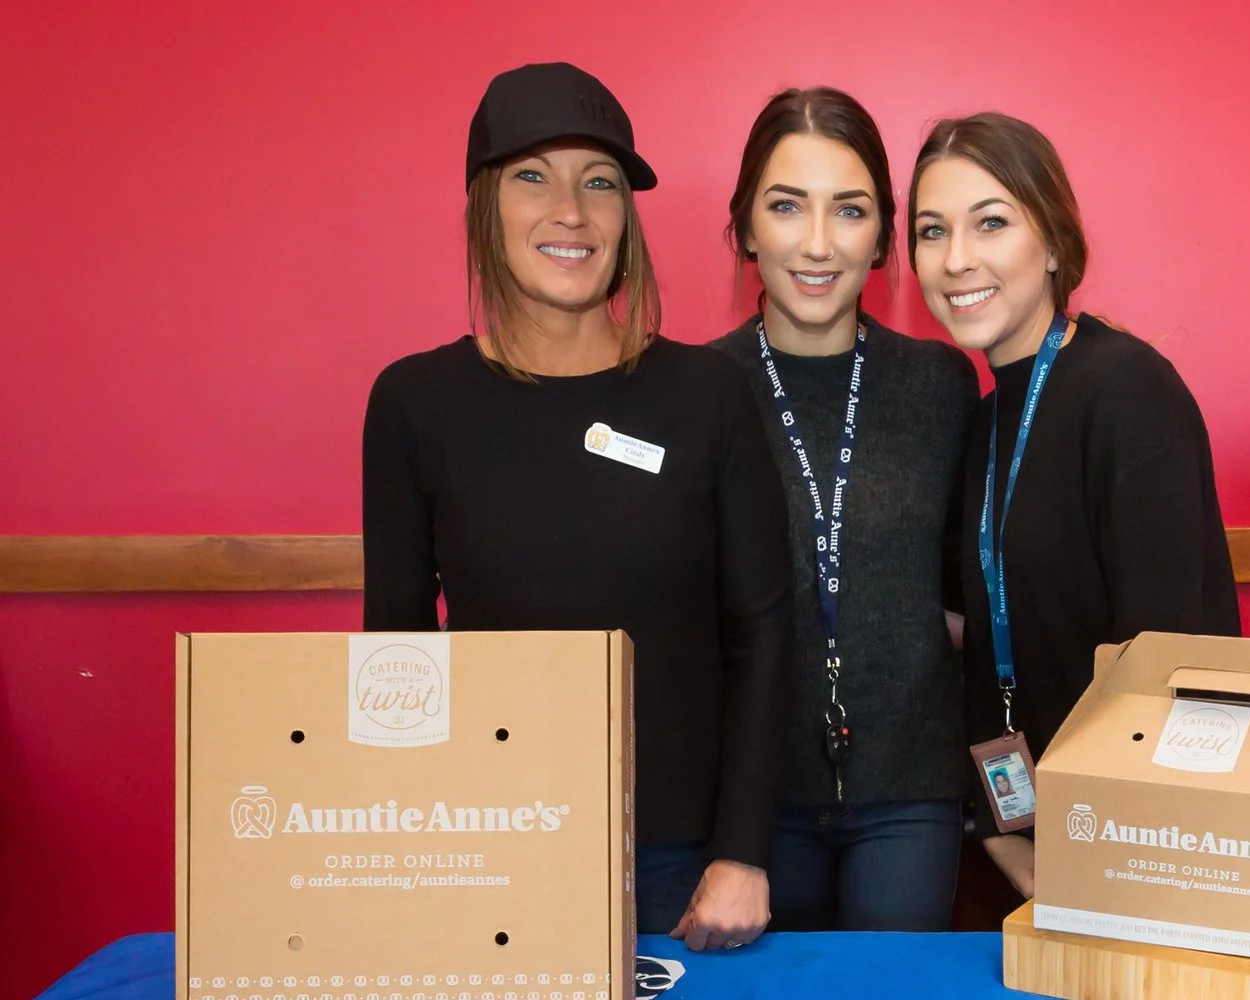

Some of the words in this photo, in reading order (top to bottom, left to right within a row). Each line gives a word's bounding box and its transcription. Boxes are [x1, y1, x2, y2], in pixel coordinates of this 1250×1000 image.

[766, 359, 786, 398] Auntie
[850, 352, 865, 393] Auntie
[809, 476, 824, 520] Auntie
[832, 476, 847, 517] Auntie
[369, 662, 431, 676] CATERING
[359, 685, 440, 717] twist
[1183, 719, 1233, 730] CATERING
[1166, 731, 1232, 756] twist
[325, 854, 395, 869] ORDER
[404, 854, 485, 868] ONLINE
[1128, 858, 1177, 874] ORDER
[1182, 864, 1241, 882] ONLINE
[308, 874, 510, 889] order.catering/auntieannes
[1161, 928, 1181, 938] PARTY
[1182, 931, 1210, 943] STARTED
